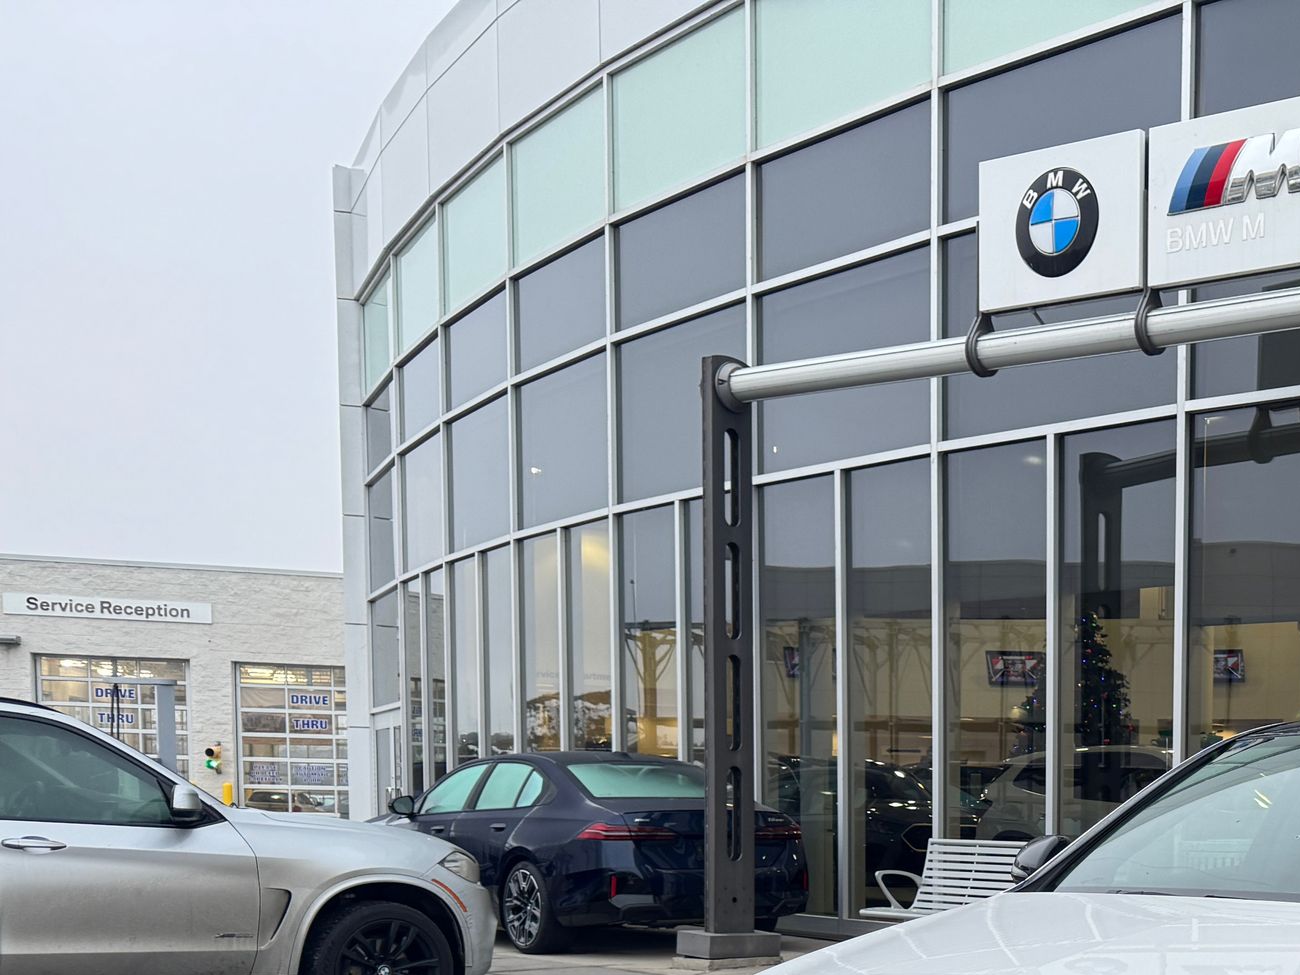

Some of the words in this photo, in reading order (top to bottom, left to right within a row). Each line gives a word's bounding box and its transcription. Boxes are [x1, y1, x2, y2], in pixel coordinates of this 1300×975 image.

[1023, 170, 1091, 209] BMW
[1166, 217, 1234, 254] BMW
[1241, 213, 1265, 242] M
[26, 597, 96, 614] Service
[100, 601, 191, 619] Reception
[291, 694, 329, 706] DRIVE
[293, 718, 328, 730] THRU
